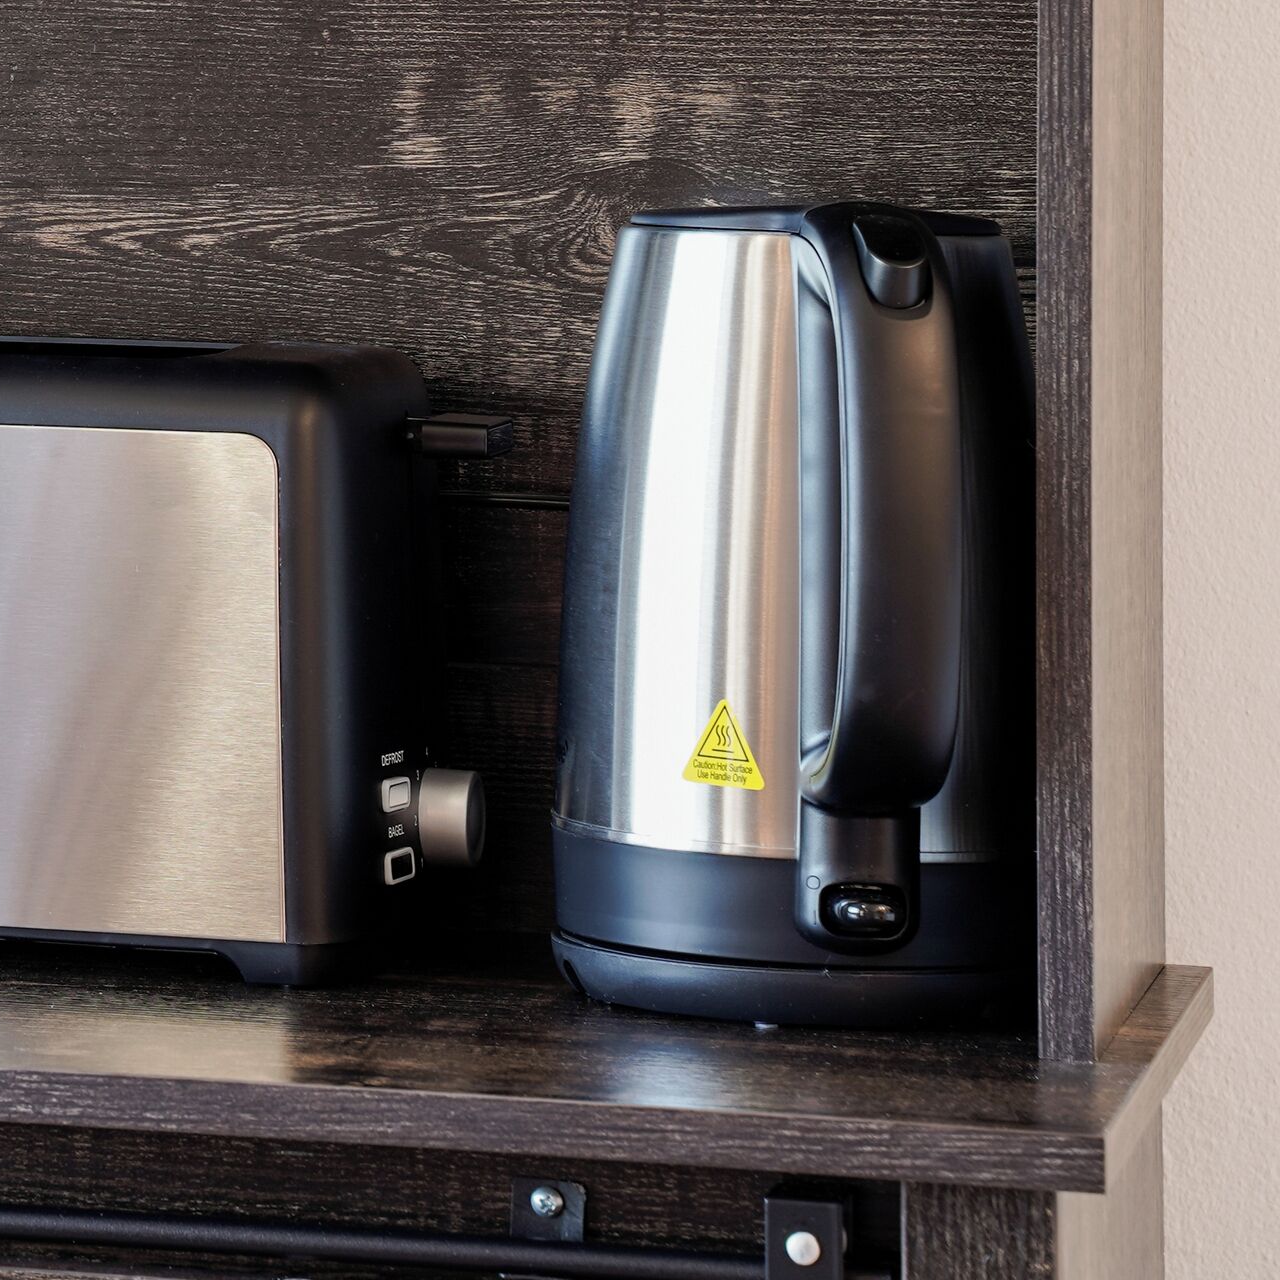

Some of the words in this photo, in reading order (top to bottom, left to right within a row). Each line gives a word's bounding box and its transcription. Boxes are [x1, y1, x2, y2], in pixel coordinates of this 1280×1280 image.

[381, 750, 405, 767] DEFROST
[729, 763, 753, 775] Surface
[697, 770, 709, 780] Use
[710, 771, 732, 782] Handle
[732, 773, 748, 786] Only
[388, 824, 405, 839] BAGEL
